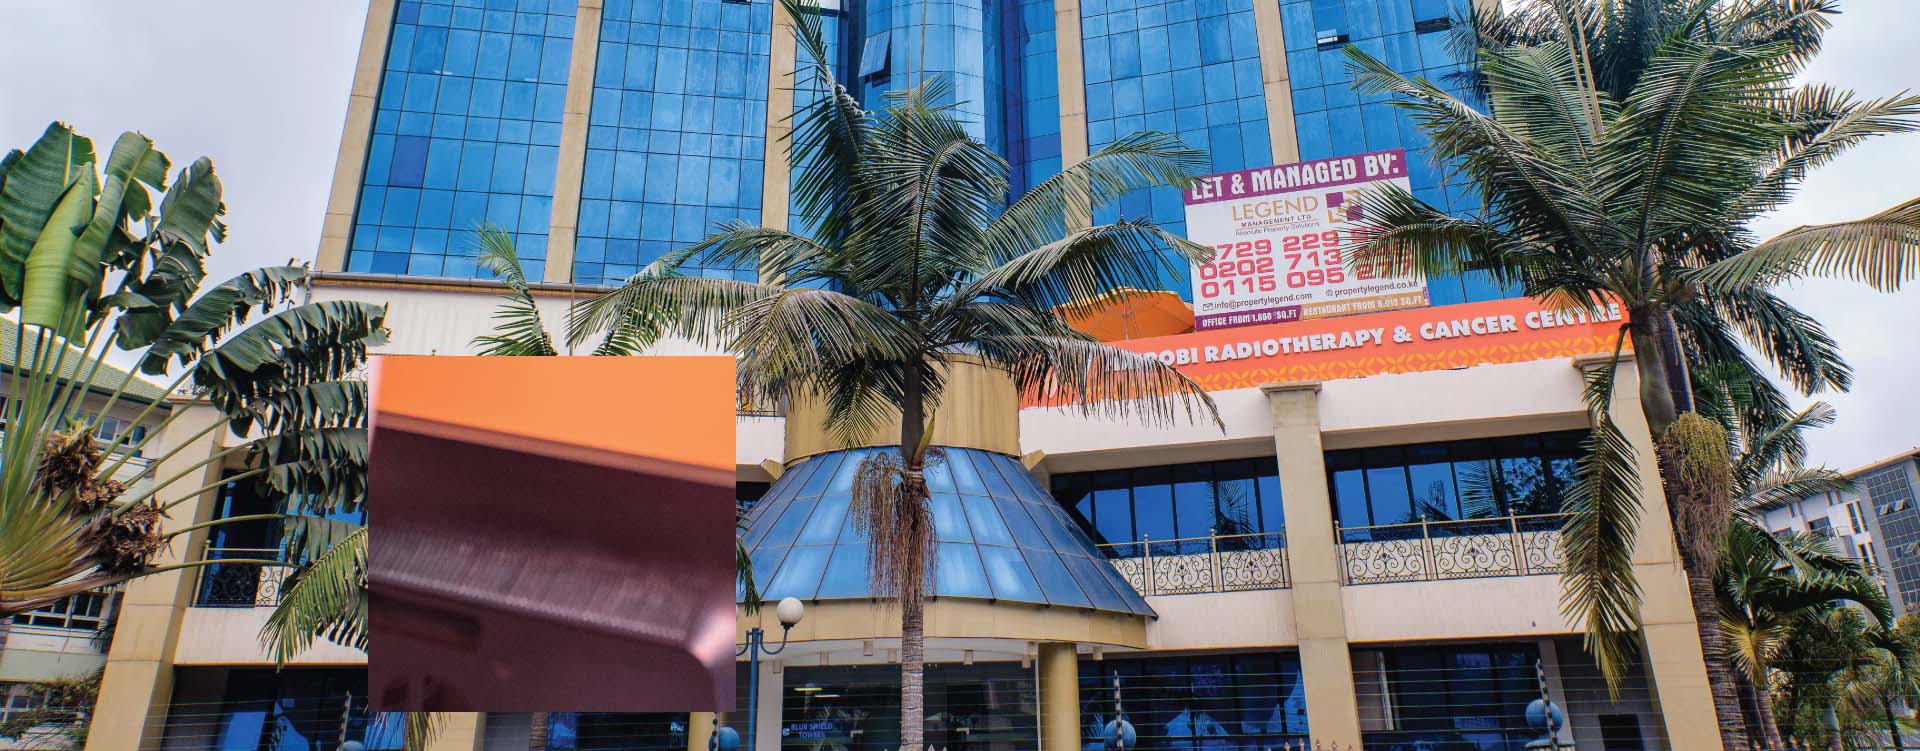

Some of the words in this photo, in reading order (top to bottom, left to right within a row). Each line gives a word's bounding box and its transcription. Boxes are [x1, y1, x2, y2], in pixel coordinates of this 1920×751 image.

[1191, 175, 1223, 200] LET
[1231, 173, 1246, 194] &
[1252, 158, 1357, 193] MANAGED
[1364, 152, 1400, 177] BY:
[1232, 195, 1319, 221] LEGEND
[1241, 216, 1294, 227] MANAGEMENT
[1264, 224, 1289, 233] Property
[1282, 230, 1340, 253] 229
[1200, 257, 1274, 281] 0202
[1285, 248, 1342, 271] 713
[1201, 274, 1276, 299] 0115
[1286, 266, 1345, 289] 095
[1334, 281, 1418, 298] propertylegend.co.ke
[1214, 292, 1312, 310] info@propertylegend.com
[1202, 316, 1227, 328] OFFICE
[1229, 314, 1251, 324] FROM
[1205, 327, 1385, 363] RADIOTHERAPY
[1392, 324, 1414, 344] &
[1420, 313, 1518, 341] CANCER
[1525, 302, 1623, 331] CENTRE
